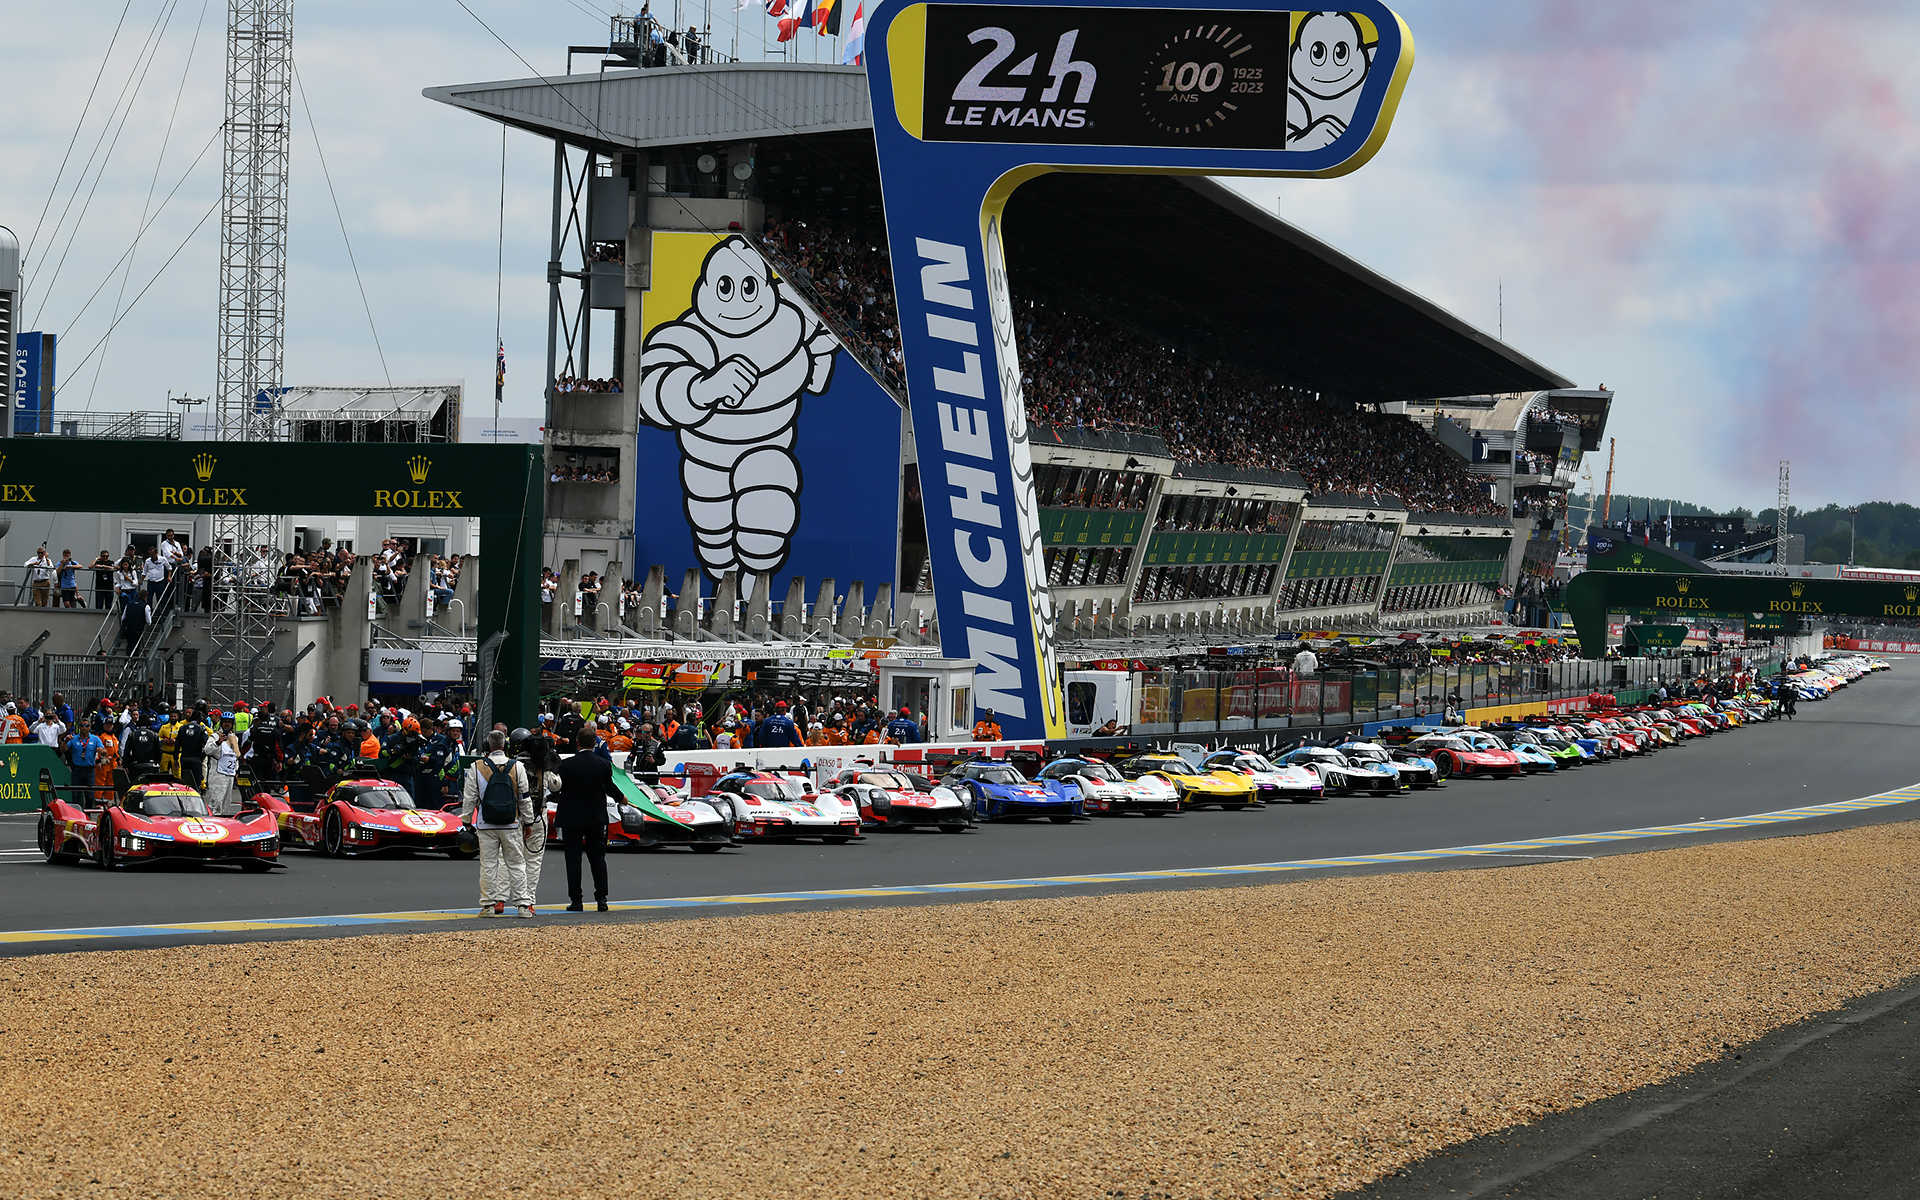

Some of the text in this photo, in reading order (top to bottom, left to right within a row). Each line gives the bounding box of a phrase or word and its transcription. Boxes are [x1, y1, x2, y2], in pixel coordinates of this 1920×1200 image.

[951, 26, 1097, 104] 24h
[1156, 61, 1225, 93] 100
[1233, 67, 1264, 80] 1923
[1230, 81, 1264, 95] 2023
[1169, 93, 1199, 103] ANS
[945, 106, 1089, 128] LE MANS
[915, 236, 1027, 720] MICHELIN
[160, 486, 248, 506] ROLEX
[373, 489, 463, 509] ROLEX
[1656, 595, 1710, 610] ROLEX
[1769, 599, 1824, 613] ROLEX
[876, 637, 885, 649] 14
[1646, 638, 1673, 646] ROLEX
[1885, 643, 1903, 652] MOTUL
[380, 656, 412, 667] Hendrick
[562, 658, 580, 671] 24
[688, 661, 702, 673] 100
[1107, 662, 1118, 670] 50
[650, 667, 661, 675] 31
[703, 664, 713, 672] 41
[818, 758, 836, 768] DENSO
[410, 816, 437, 826] 51
[189, 824, 217, 834] 50
